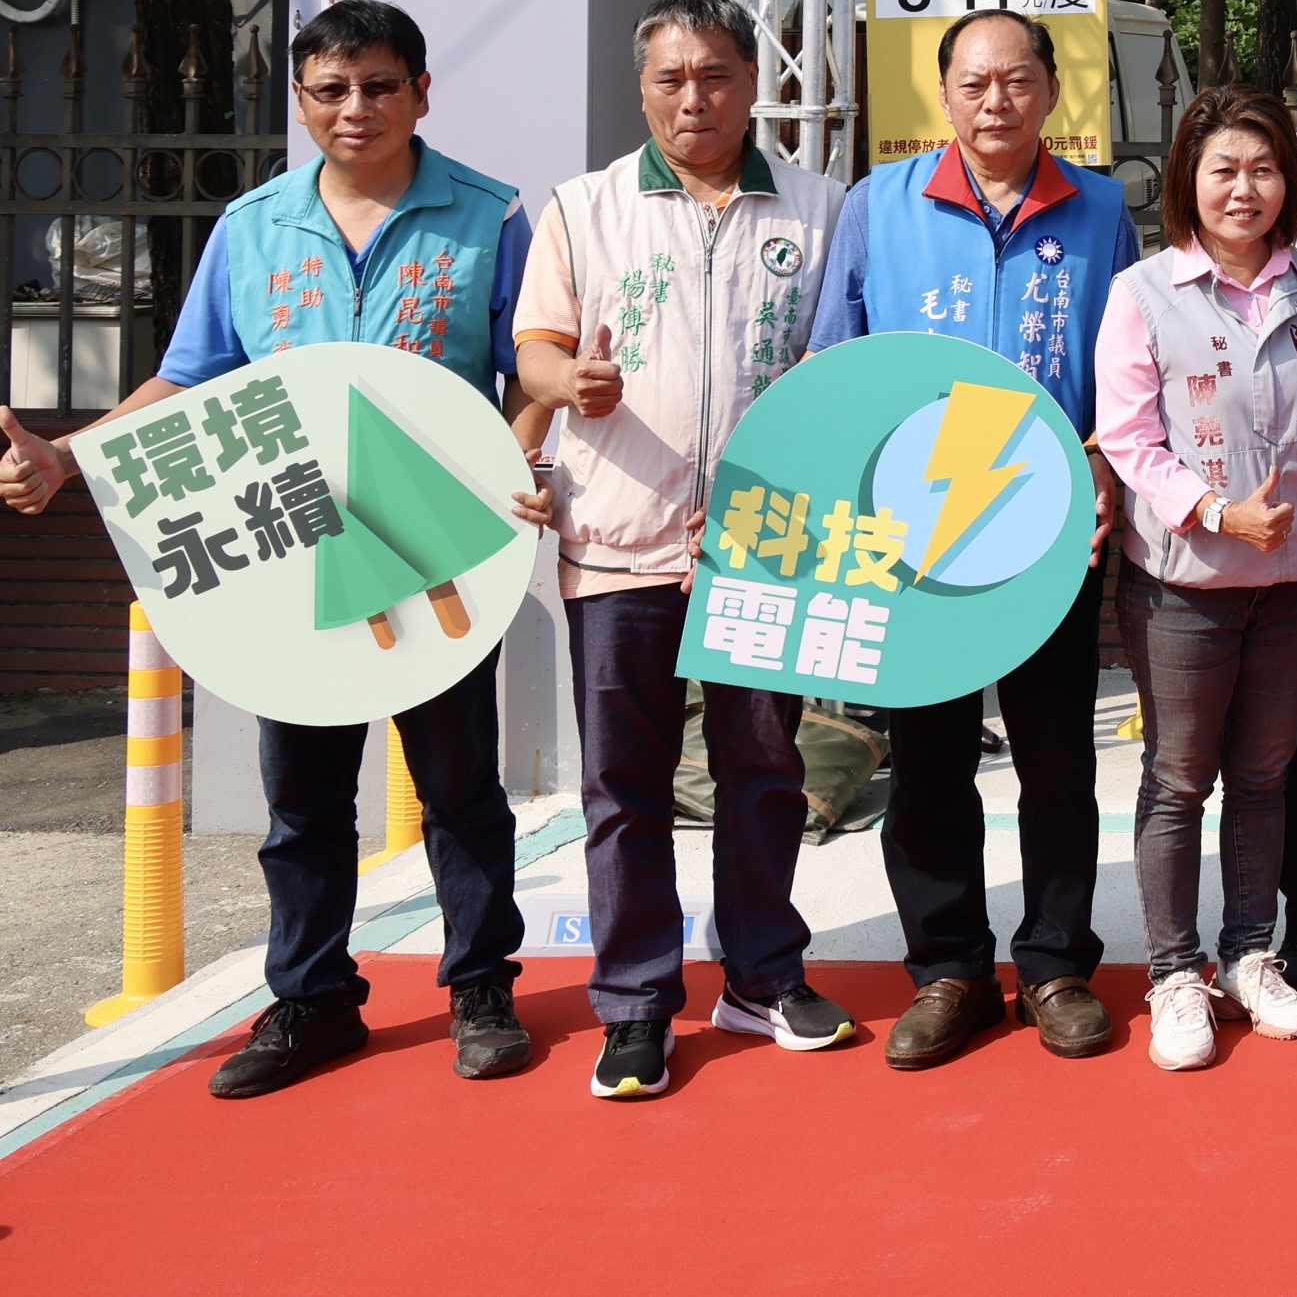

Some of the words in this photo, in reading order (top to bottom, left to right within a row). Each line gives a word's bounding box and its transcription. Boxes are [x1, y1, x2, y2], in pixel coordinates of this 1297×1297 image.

[300, 255, 324, 309] 特助
[393, 260, 428, 353] 陳昆和
[428, 250, 454, 359] 台南市議員
[650, 252, 675, 304] 秘書
[950, 273, 973, 323] 秘書
[1016, 271, 1050, 380] 尤榮智
[1047, 269, 1071, 380] 台南市議員
[1210, 336, 1233, 378] 秘書
[100, 375, 309, 519] 環境
[152, 459, 344, 600] 永續
[718, 485, 909, 592] 科技
[703, 576, 890, 685] 電能
